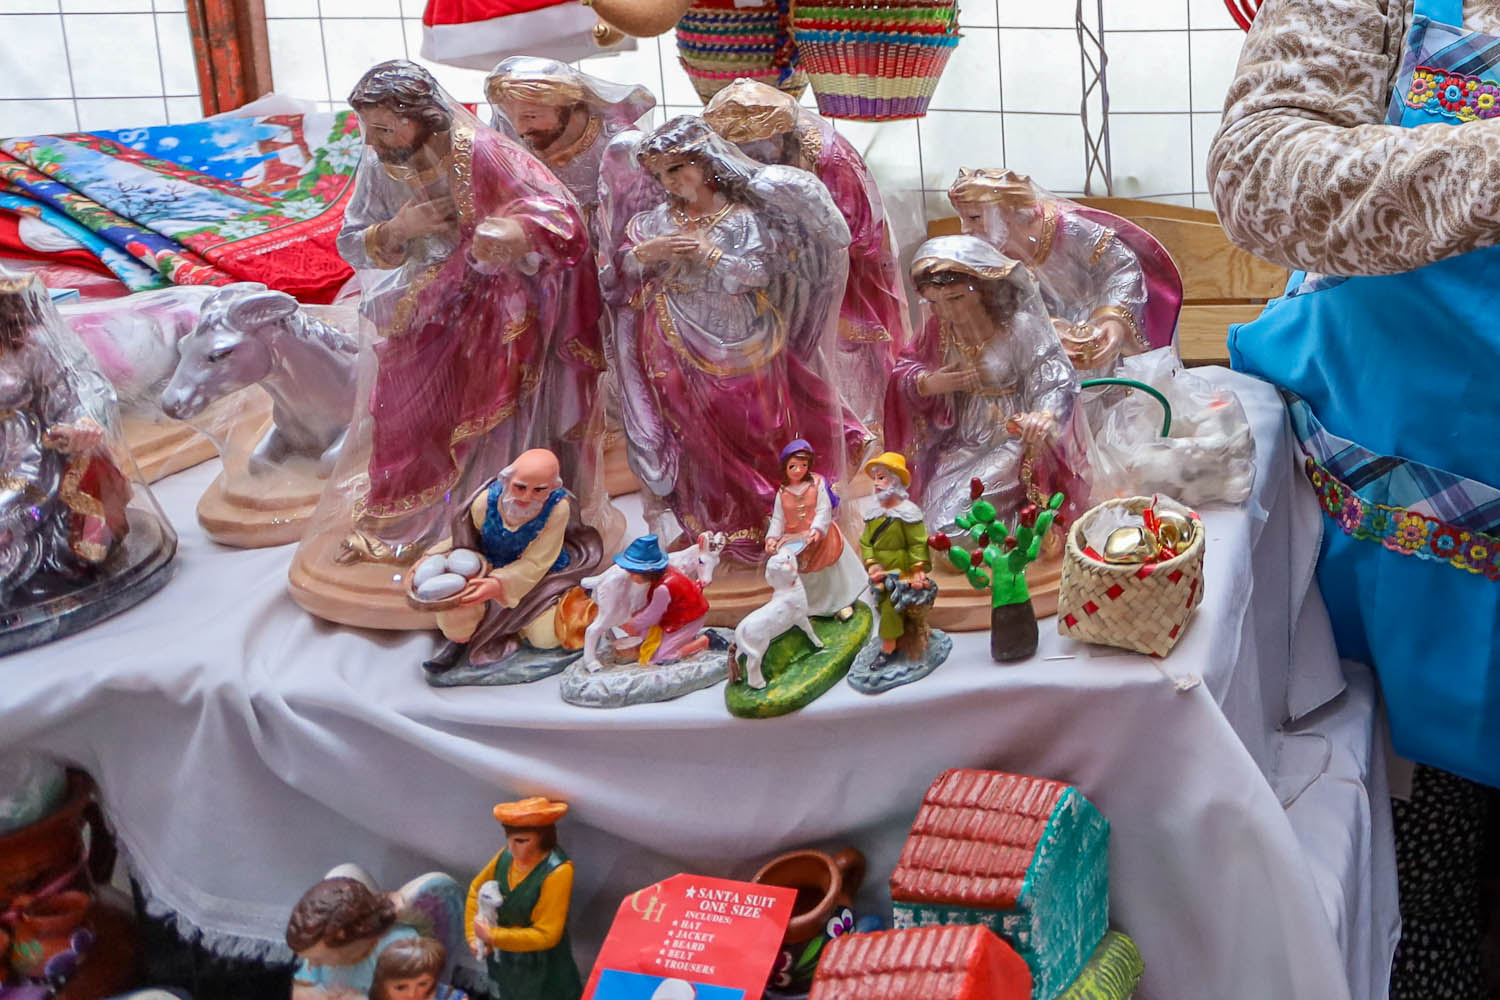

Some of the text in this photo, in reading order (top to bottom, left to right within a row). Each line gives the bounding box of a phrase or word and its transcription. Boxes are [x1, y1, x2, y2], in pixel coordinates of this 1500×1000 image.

[697, 887, 777, 909] SANTA SUIT
[699, 900, 763, 919] ONE SIZE
[680, 920, 702, 930] HAT
[675, 930, 716, 943] JACKET
[672, 939, 706, 952] BEARD
[667, 948, 694, 961] BELT
[664, 959, 716, 975] TROUSERS
